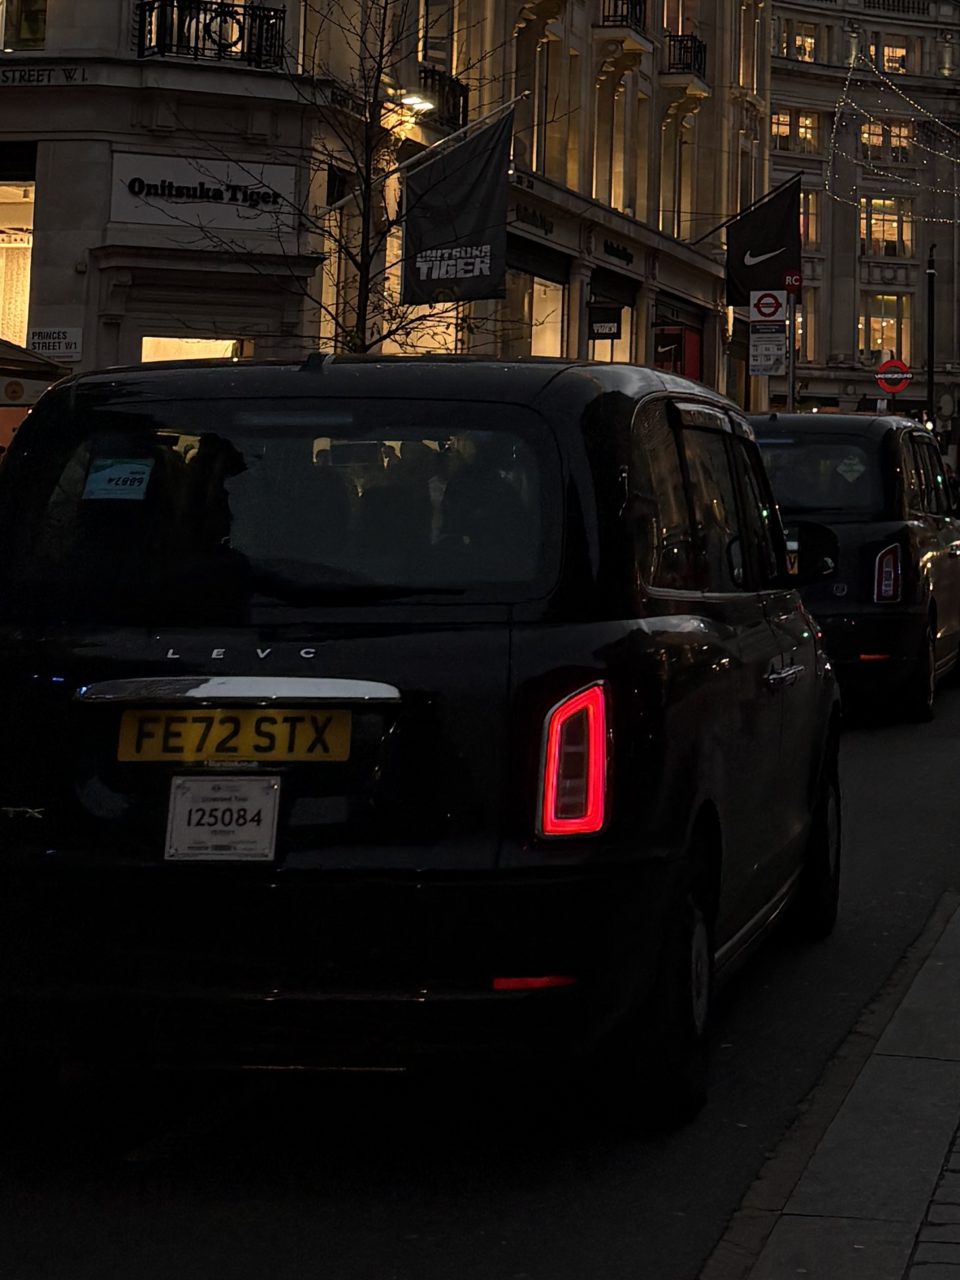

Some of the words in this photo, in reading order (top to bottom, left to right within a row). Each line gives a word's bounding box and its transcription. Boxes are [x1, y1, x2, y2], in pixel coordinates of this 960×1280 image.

[1, 68, 55, 83] STREET
[128, 177, 224, 200] Onitsuka
[226, 184, 281, 207] Tiger
[415, 257, 491, 281] TIGER
[785, 275, 800, 286] RC
[31, 331, 68, 340] PRINCES
[31, 341, 61, 351] STREET
[65, 342, 77, 350] W1
[166, 648, 318, 660] LEVC
[135, 716, 241, 754] FE72
[252, 716, 334, 754] STX
[187, 807, 263, 827] 125084
